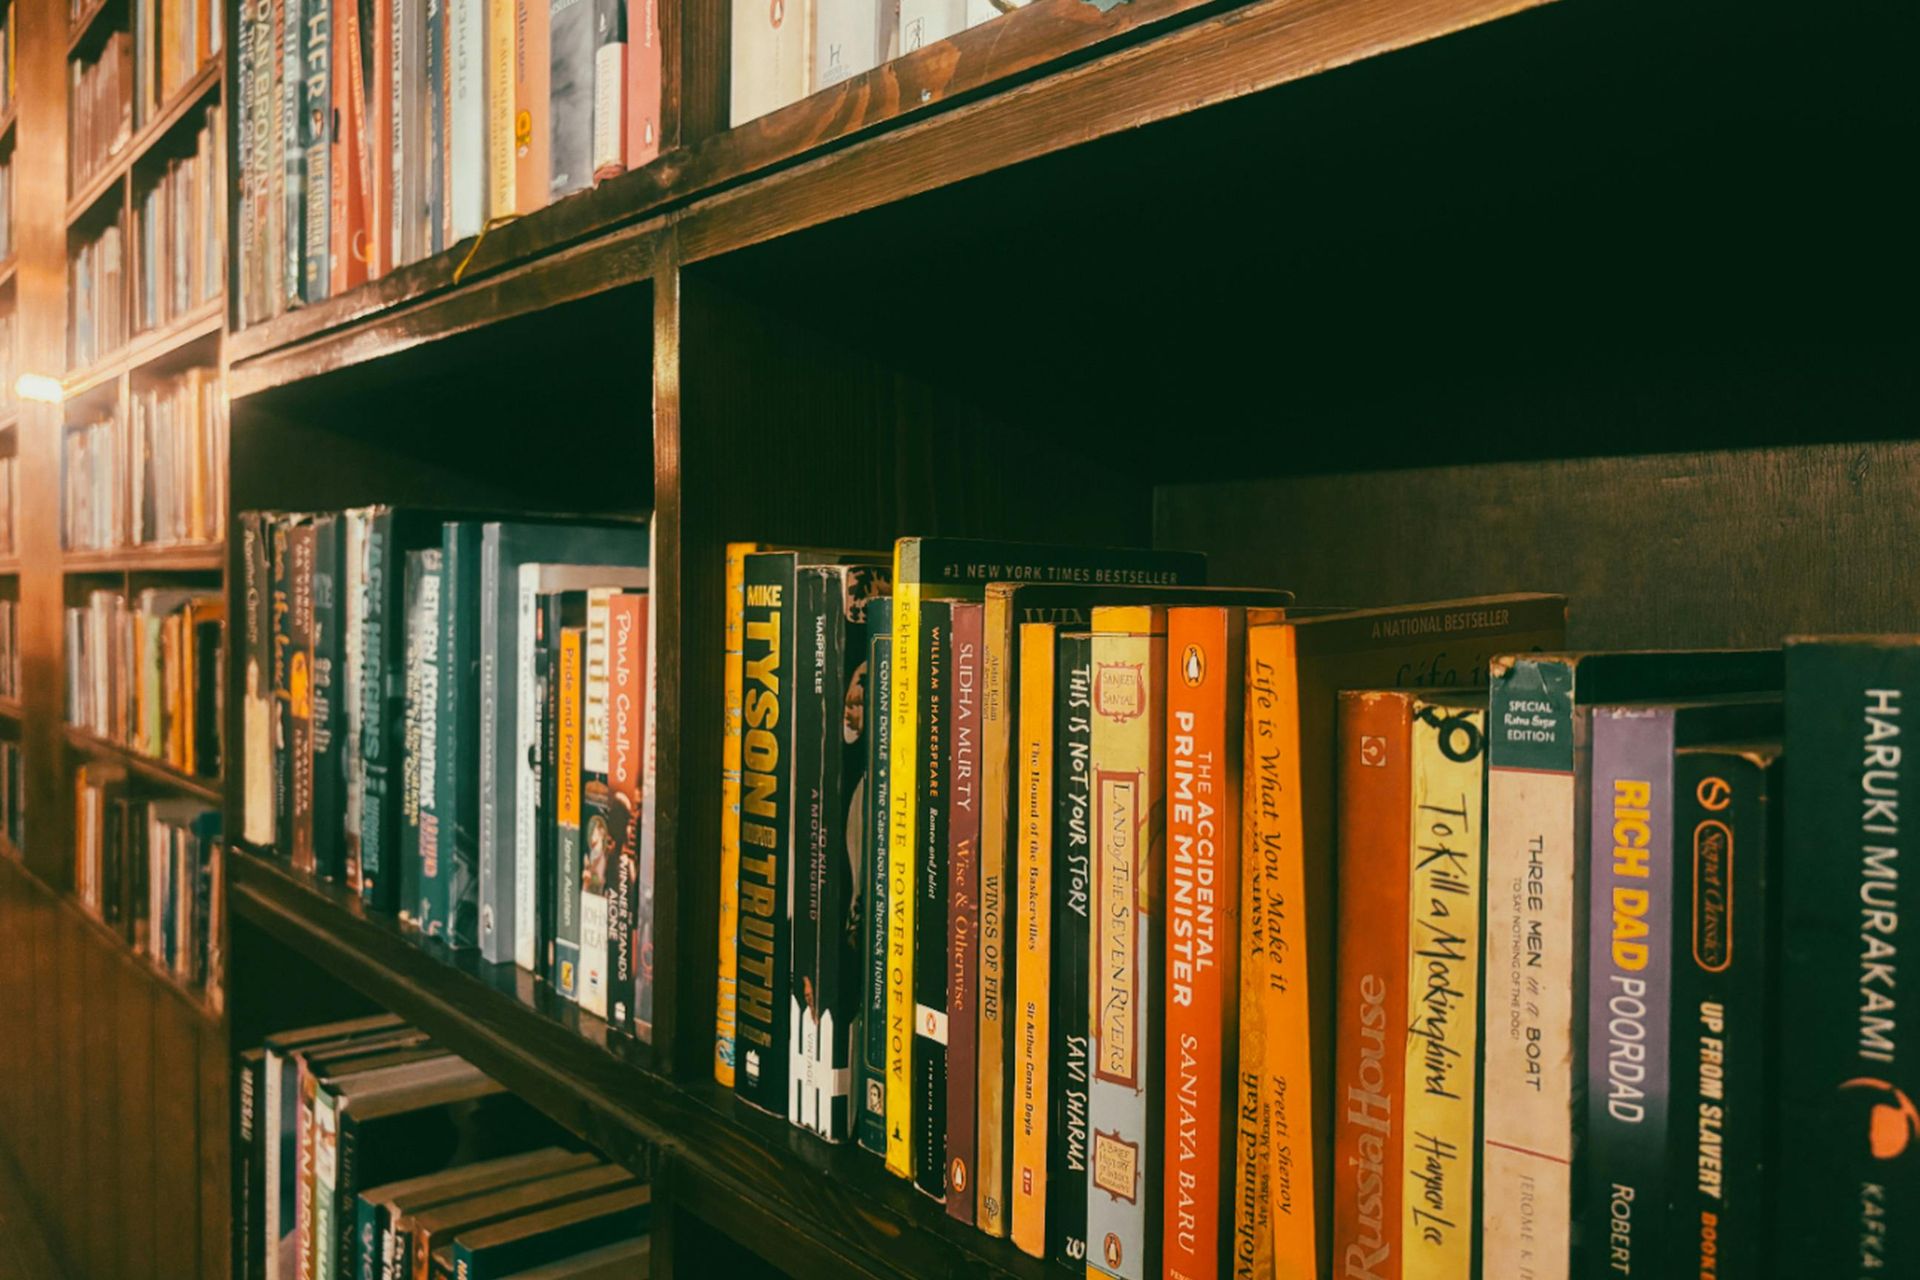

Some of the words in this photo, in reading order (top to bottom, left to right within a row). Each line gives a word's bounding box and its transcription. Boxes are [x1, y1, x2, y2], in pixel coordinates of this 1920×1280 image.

[254, 71, 270, 196] BROWN
[367, 532, 383, 615] JACK
[747, 585, 783, 607] MIKE
[967, 565, 1000, 579] NEW
[1005, 566, 1043, 581] YORK
[1047, 567, 1091, 582] TIMES
[1096, 568, 1179, 586] BESTSELLER
[616, 609, 632, 687] Paulo
[815, 614, 826, 668] HARPER
[898, 601, 912, 672] Eckhart
[1372, 623, 1381, 639] A
[1383, 616, 1443, 637] NATIONAL
[1445, 609, 1511, 632] BESTSELLER
[564, 647, 575, 691] Pride
[814, 669, 825, 694] LEE
[930, 627, 940, 690] WILLIAM
[959, 642, 974, 720] SUDHA
[990, 655, 1000, 686] Abdul
[1251, 657, 1279, 710] Life
[365, 622, 382, 760] HIGGINS
[563, 696, 575, 728] and
[879, 660, 890, 712] CONAN
[897, 678, 911, 726] Tolle
[989, 689, 1000, 721] Kalam
[1068, 663, 1090, 709] THIS
[1508, 700, 1554, 714] SPECIAL
[616, 692, 631, 783] Coelho
[743, 611, 780, 818] TYSON
[878, 714, 890, 760] DOYLE
[1068, 715, 1089, 734] IS
[1258, 718, 1277, 740] is
[1507, 730, 1556, 742] EDITION
[562, 732, 575, 813] Prejudice
[929, 694, 940, 797] SHAKESPEARE
[956, 726, 973, 812] MURTY
[1031, 741, 1041, 767] The
[1068, 741, 1090, 792] NOT
[1174, 709, 1194, 826] PRIME
[1197, 750, 1213, 795] THE
[1861, 688, 1902, 836] HARUKI
[811, 788, 820, 800] A
[877, 782, 888, 807] The
[1030, 771, 1041, 818] Hound
[1259, 748, 1283, 822] What
[896, 793, 908, 848] THE
[927, 807, 938, 842] Romeo
[1030, 821, 1041, 836] of
[1067, 792, 1089, 848] YOUR
[1417, 792, 1469, 838] To
[1612, 779, 1651, 879] RICH
[562, 836, 574, 873] Jane
[809, 803, 820, 921] MOCKINGBIRD
[819, 854, 829, 887] KILL
[927, 843, 938, 867] and
[954, 839, 971, 886] Wise
[1029, 840, 1041, 861] the
[1263, 830, 1283, 881] You
[1414, 842, 1470, 896] Kill
[1527, 834, 1545, 911] THREE
[1700, 828, 1723, 887] Signet
[562, 876, 574, 927] Austen
[618, 854, 629, 919] WINNER
[892, 861, 907, 957] POWER
[954, 892, 971, 908] &
[984, 875, 999, 939] WINGS
[1027, 866, 1040, 951] Baskervilles
[1067, 854, 1089, 919] STORY
[1196, 800, 1215, 973] ACCIDENTAL
[1430, 897, 1451, 918] a
[1512, 876, 1523, 892] TO
[1512, 892, 1523, 914] SAY
[608, 887, 619, 942] ALONE
[873, 901, 886, 956] Sherlock
[1173, 834, 1194, 1008] MINISTER
[1265, 888, 1291, 964] Make
[1611, 886, 1650, 972] DAD
[617, 920, 629, 981] STANDS
[952, 915, 971, 1012] Otherwise
[984, 944, 998, 972] OF
[1511, 915, 1523, 969] NOTHING
[1526, 919, 1543, 968] MEN
[1859, 845, 1899, 1063] MURAKAMI
[872, 959, 884, 1010] Holmes
[892, 966, 904, 1002] OF
[984, 976, 998, 1022] FIRE
[1269, 973, 1288, 995] it
[1511, 970, 1522, 986] OF
[1511, 986, 1522, 1008] THE
[1526, 975, 1547, 997] in
[1025, 1002, 1036, 1020] Sir
[1102, 985, 1130, 1075] RIVERS
[1408, 918, 1468, 1100] Mockingbird
[1699, 1001, 1724, 1033] UP
[805, 1031, 815, 1089] VINTAGE
[891, 1014, 904, 1084] NOW
[1025, 1021, 1036, 1060] Arthur
[1066, 1034, 1088, 1082] SAVI
[1345, 974, 1392, 1139] House
[1525, 1025, 1543, 1092] BOAT
[1025, 1062, 1036, 1100] Conan
[1699, 1036, 1724, 1100] FROM
[1024, 1102, 1036, 1136] Doyle
[1177, 1032, 1198, 1164] SANJAYA
[1241, 1072, 1259, 1125] Rafi
[1272, 1075, 1289, 1138] Preeti
[300, 1103, 313, 1177] DAN
[1065, 1088, 1087, 1172] SHARMA
[1698, 1102, 1724, 1199] SLAVERY
[1275, 1145, 1293, 1215] Shenoy
[1410, 1130, 1458, 1211] Harper
[1177, 1169, 1197, 1257] BARU
[1237, 1128, 1257, 1280] Mohammed
[1344, 1131, 1391, 1280] Russia
[1412, 1205, 1456, 1247] Lee
[1518, 1174, 1536, 1242] JEROME
[1610, 1182, 1636, 1277] ROBERT
[1860, 1182, 1886, 1269] KAFKA
